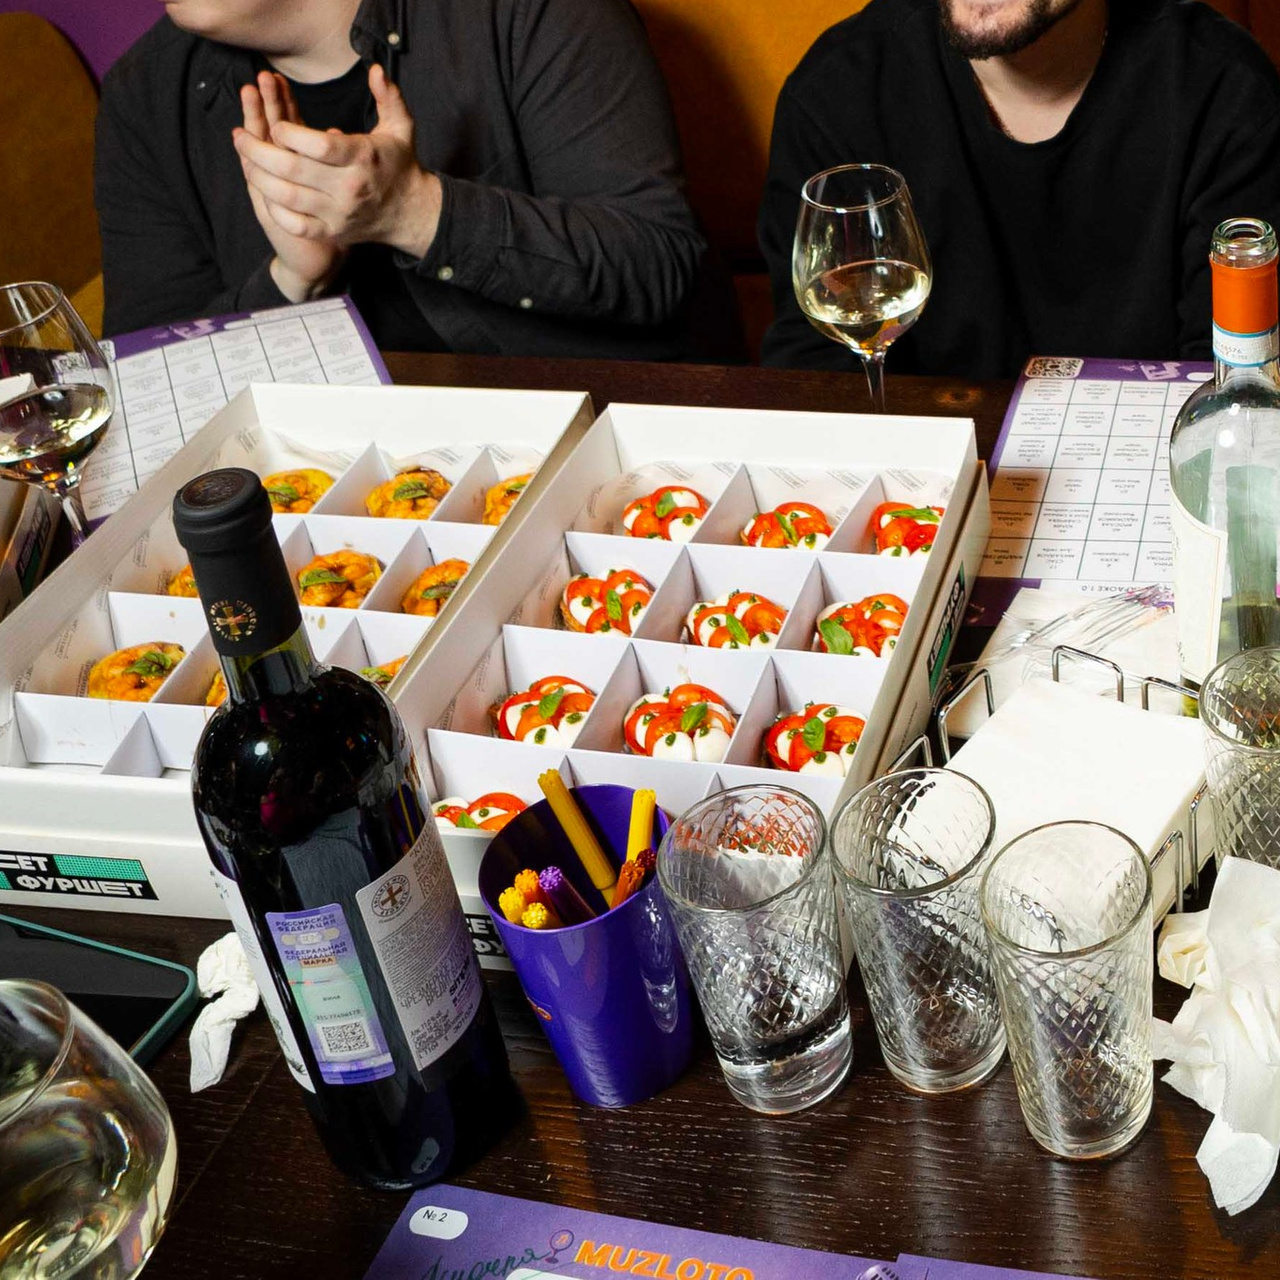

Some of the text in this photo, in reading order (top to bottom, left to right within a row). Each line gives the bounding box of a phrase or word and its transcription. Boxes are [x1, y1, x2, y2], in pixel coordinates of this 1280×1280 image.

[16, 874, 144, 897] ФУРШЕТ
[275, 913, 335, 926] РОССИЙСКАЯ
[277, 919, 336, 932] ФЕДЕРАЦИЯ
[284, 941, 346, 956] ФЕДЕРАЛЬНАЯ
[286, 947, 348, 961] СПЕЦИАЛЬНАЯ
[303, 957, 333, 966] МАРКА
[422, 1209, 448, 1223] № 2
[573, 1239, 755, 1280] MUZLOTO
